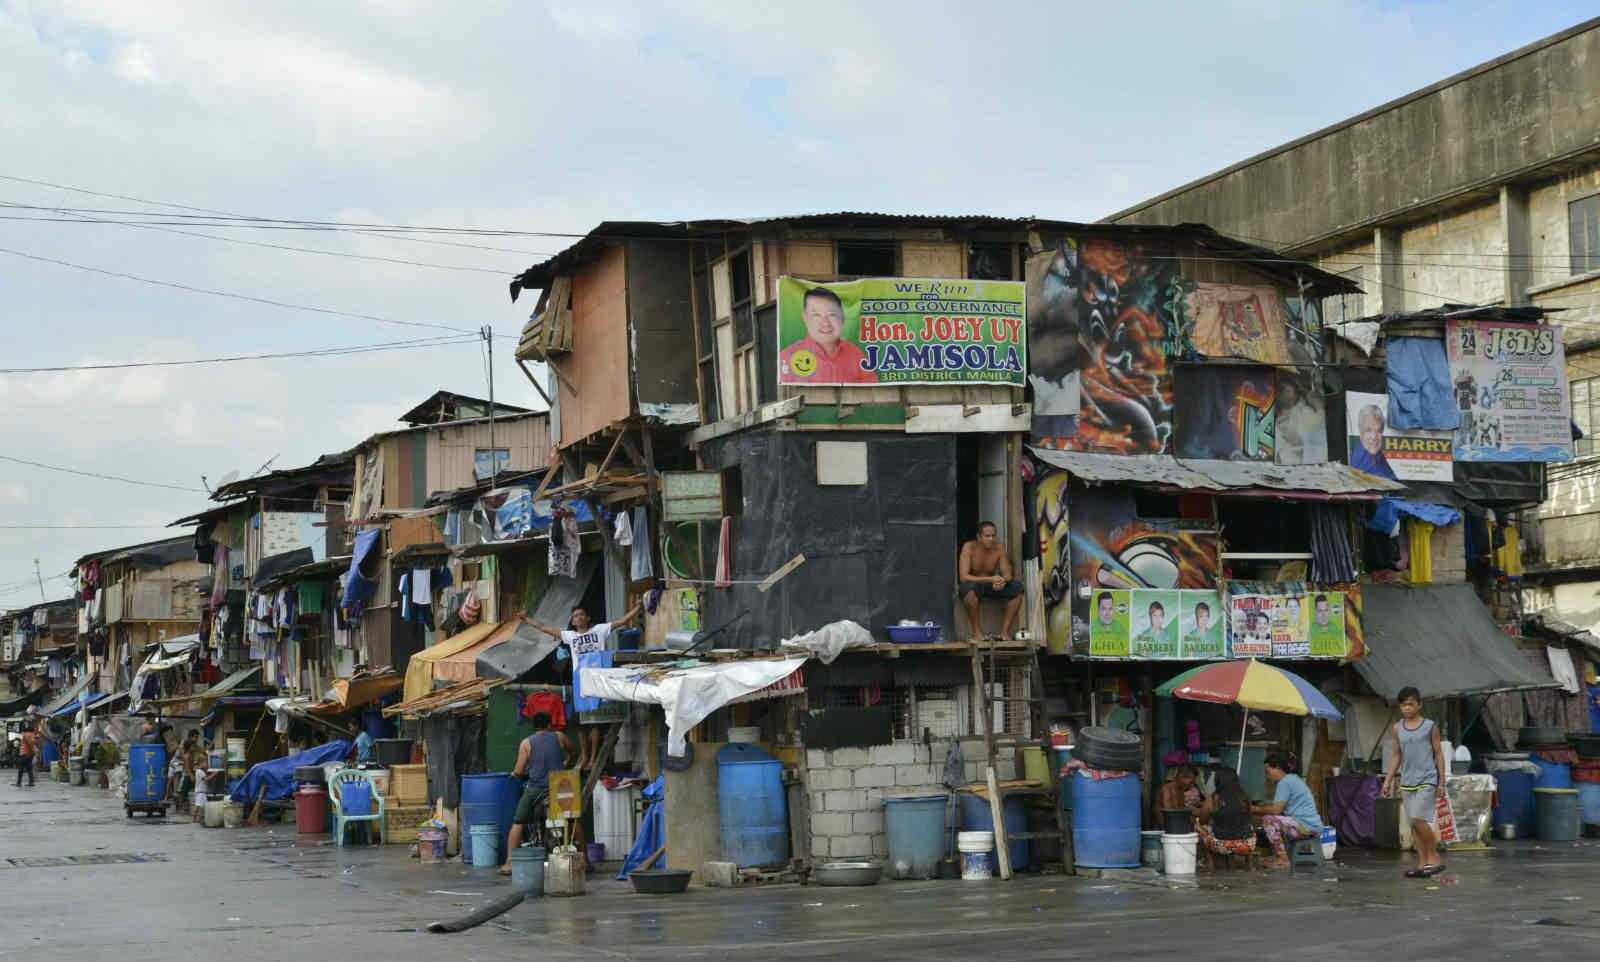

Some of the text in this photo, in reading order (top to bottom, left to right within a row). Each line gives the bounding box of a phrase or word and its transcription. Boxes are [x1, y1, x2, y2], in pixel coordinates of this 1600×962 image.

[894, 281, 968, 295] WE Run
[861, 301, 1019, 314] GOOD GOVERNANCE
[860, 316, 1022, 343] Hon. JOEY UY
[1461, 335, 1476, 349] 24
[861, 344, 1023, 371] JAMISOLA
[881, 371, 1012, 381] 3RD DISTRICT MANILA
[1385, 437, 1450, 453] HARRY
